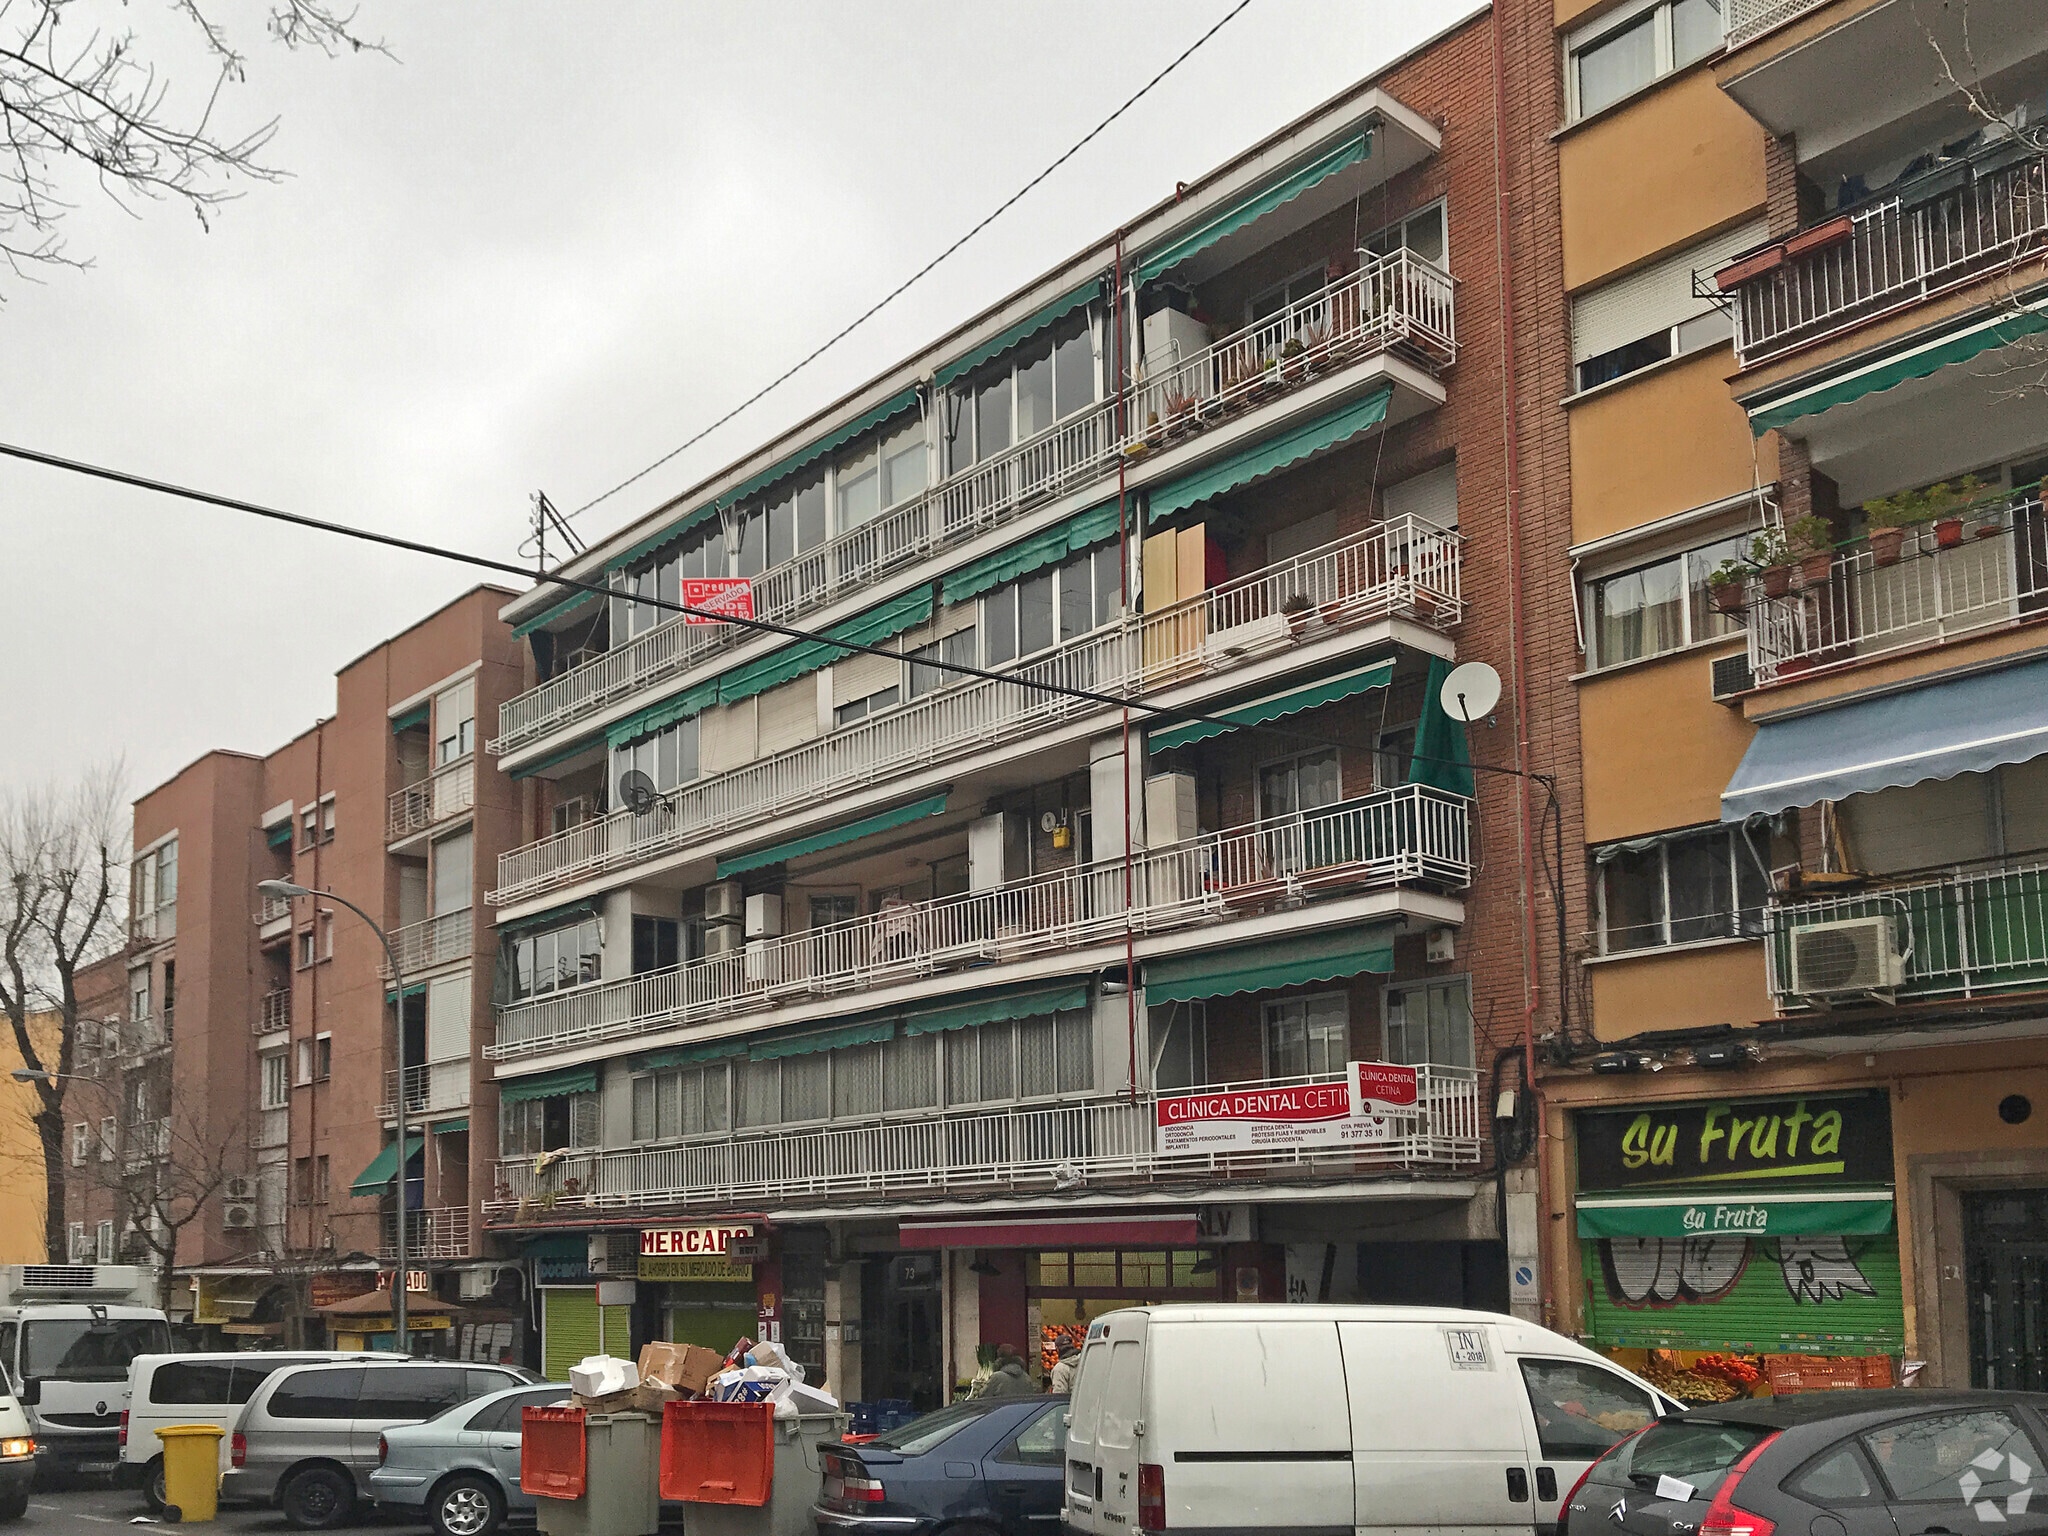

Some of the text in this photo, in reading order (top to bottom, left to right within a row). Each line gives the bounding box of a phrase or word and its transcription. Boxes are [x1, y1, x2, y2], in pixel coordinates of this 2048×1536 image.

[705, 582, 743, 594] redpi
[699, 587, 744, 612] SERVADO
[1360, 1069, 1415, 1084] CLÍNICA DENTAL
[1375, 1085, 1401, 1096] CETINA
[1168, 1088, 1351, 1119] CLÍNICA DENTAL CETIN
[1251, 1124, 1274, 1132] ESTÉTICA
[1294, 1128, 1326, 1136] REMOVIBLES
[1621, 1099, 1843, 1169] Su Fruta
[1165, 1134, 1236, 1144] TRATAMIENTOS PERIODONTALES
[1341, 1131, 1349, 1139] 91
[1351, 1130, 1363, 1138] 377
[1683, 1205, 1768, 1229] Su Fruta
[689, 1261, 716, 1277] MERCADO
[904, 1267, 915, 1280] 73
[1466, 1351, 1483, 1361] 2018
